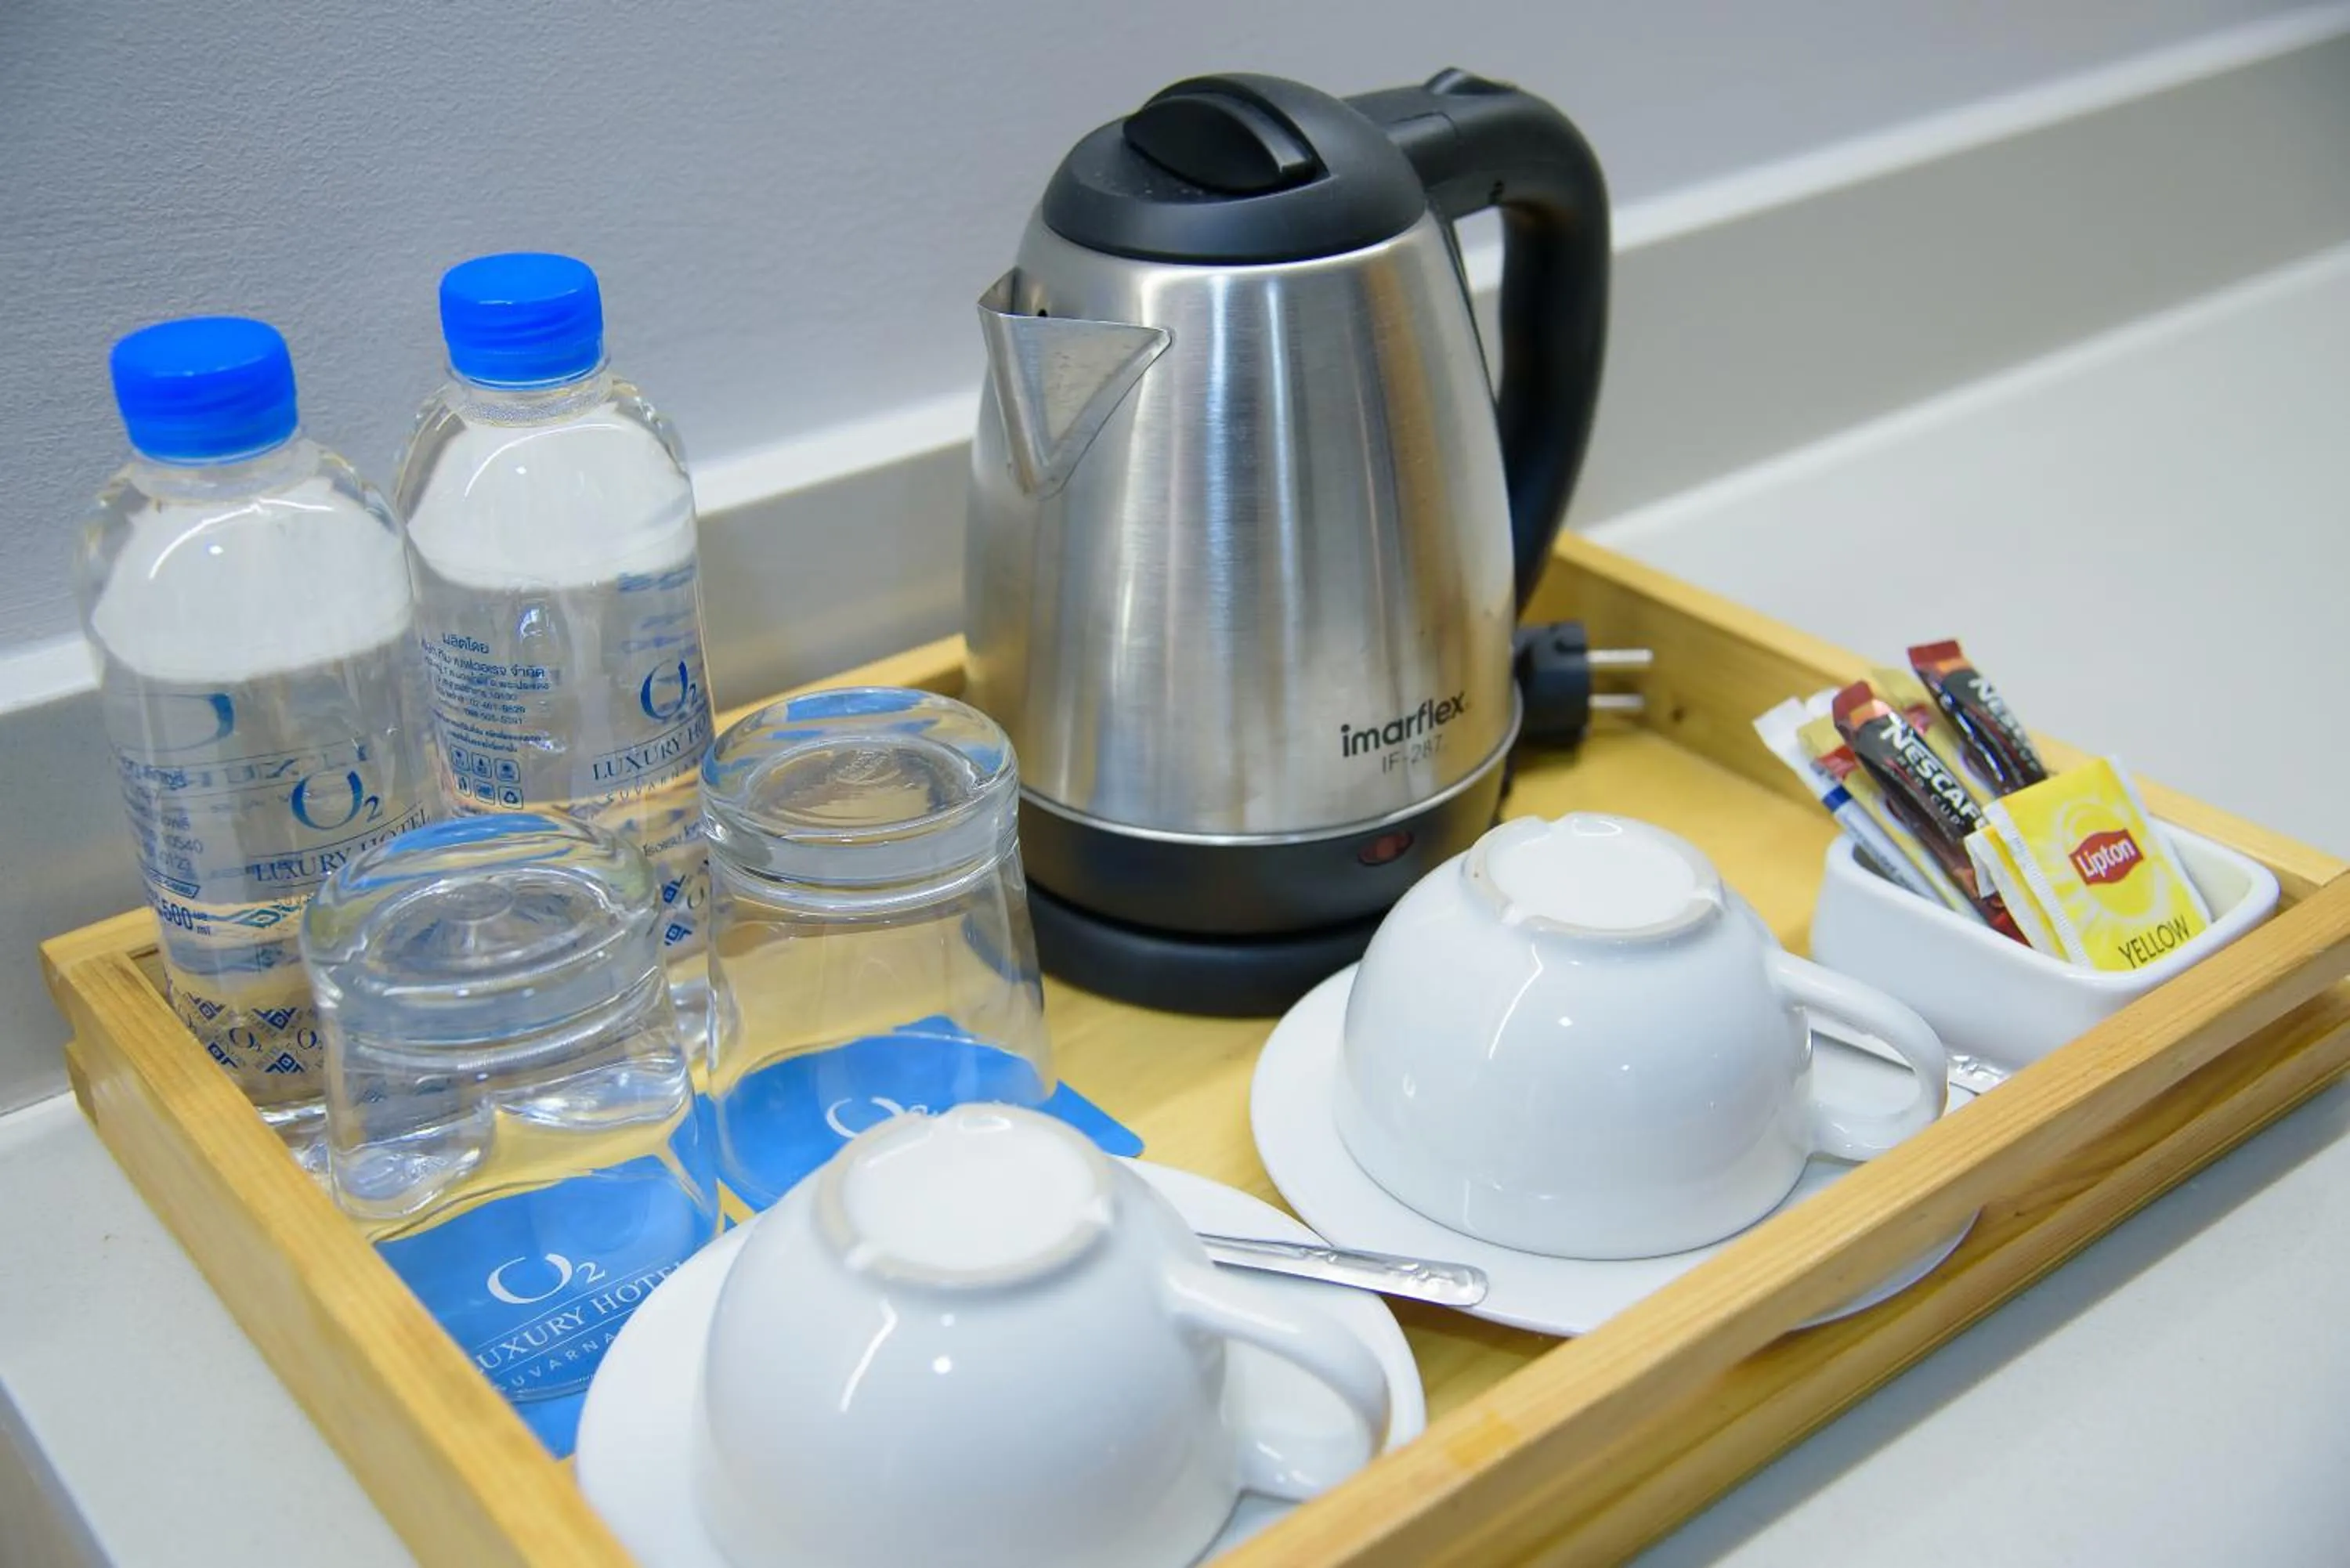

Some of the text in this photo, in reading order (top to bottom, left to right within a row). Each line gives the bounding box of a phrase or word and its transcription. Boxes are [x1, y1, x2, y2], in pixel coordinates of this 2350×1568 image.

[1340, 691, 1465, 758] imarflex
[593, 732, 682, 781] LUXURY
[255, 847, 351, 882] LUXURY
[2077, 838, 2136, 878] Lipton
[161, 900, 193, 930] 500
[2118, 914, 2190, 969] YELLOW
[476, 1306, 586, 1373] UXURY
